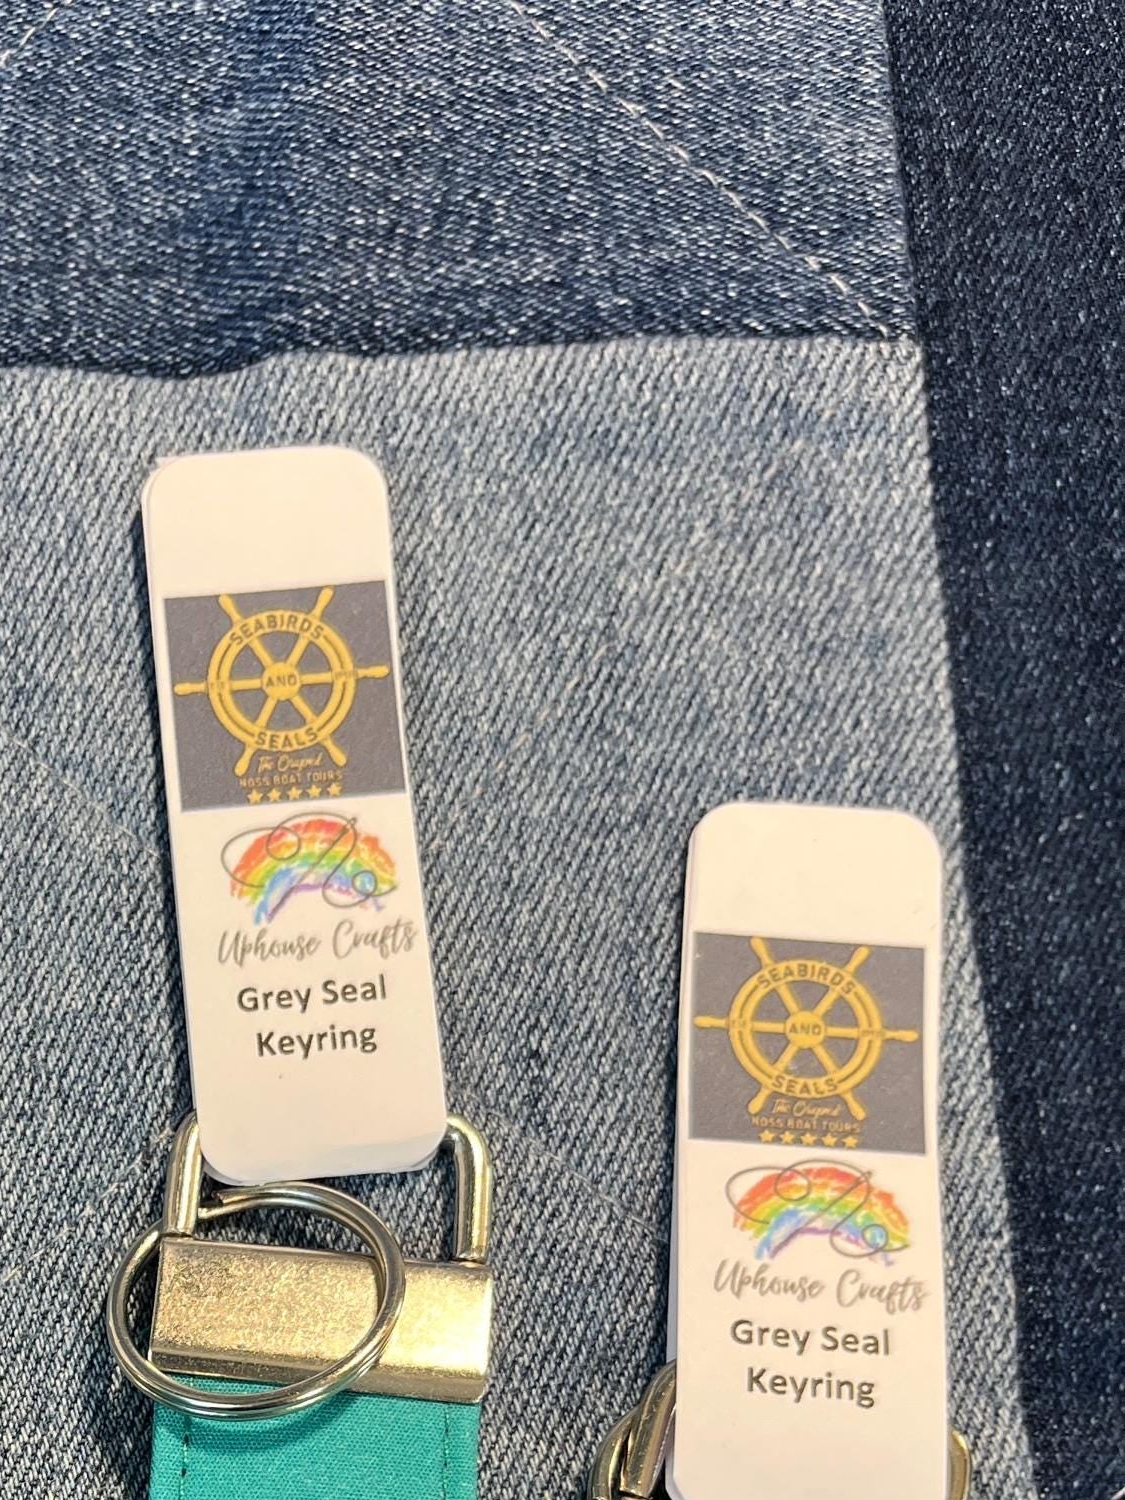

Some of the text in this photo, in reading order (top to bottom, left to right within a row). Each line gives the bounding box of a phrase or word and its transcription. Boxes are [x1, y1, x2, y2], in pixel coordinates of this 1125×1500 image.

[230, 615, 324, 645] SEABIRDS
[266, 675, 297, 687] AND
[255, 728, 317, 749] SEALS
[217, 919, 418, 968] Uphouse Crafts
[237, 974, 387, 1013] Grey Seal
[757, 963, 855, 994] SEABIRDS
[256, 1025, 377, 1059] Keyring
[789, 1024, 821, 1035] AND
[772, 1076, 837, 1095] SEALS
[713, 1260, 931, 1315] Uphouse Crafts
[731, 1319, 889, 1356] Grey Seal
[747, 1367, 875, 1409] Keyring
